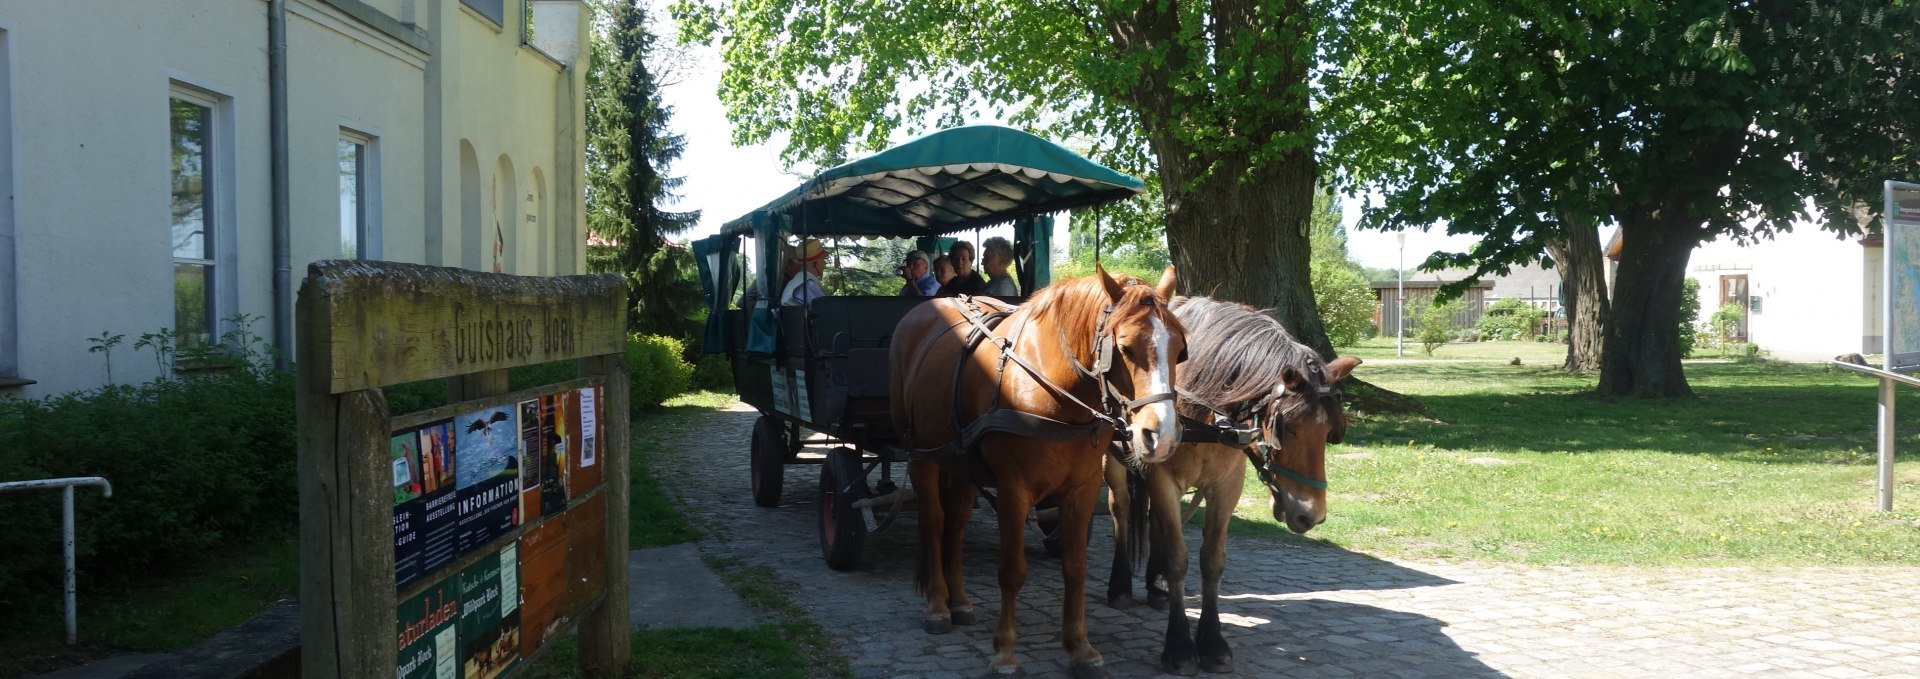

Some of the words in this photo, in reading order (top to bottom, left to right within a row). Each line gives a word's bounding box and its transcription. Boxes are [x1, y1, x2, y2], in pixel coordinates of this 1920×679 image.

[456, 303, 533, 364] Gutshaus
[544, 303, 574, 355] Boek
[426, 502, 456, 523] AUSSTELLUNG
[458, 477, 519, 517] INFORMATION
[397, 588, 457, 651] aturladen
